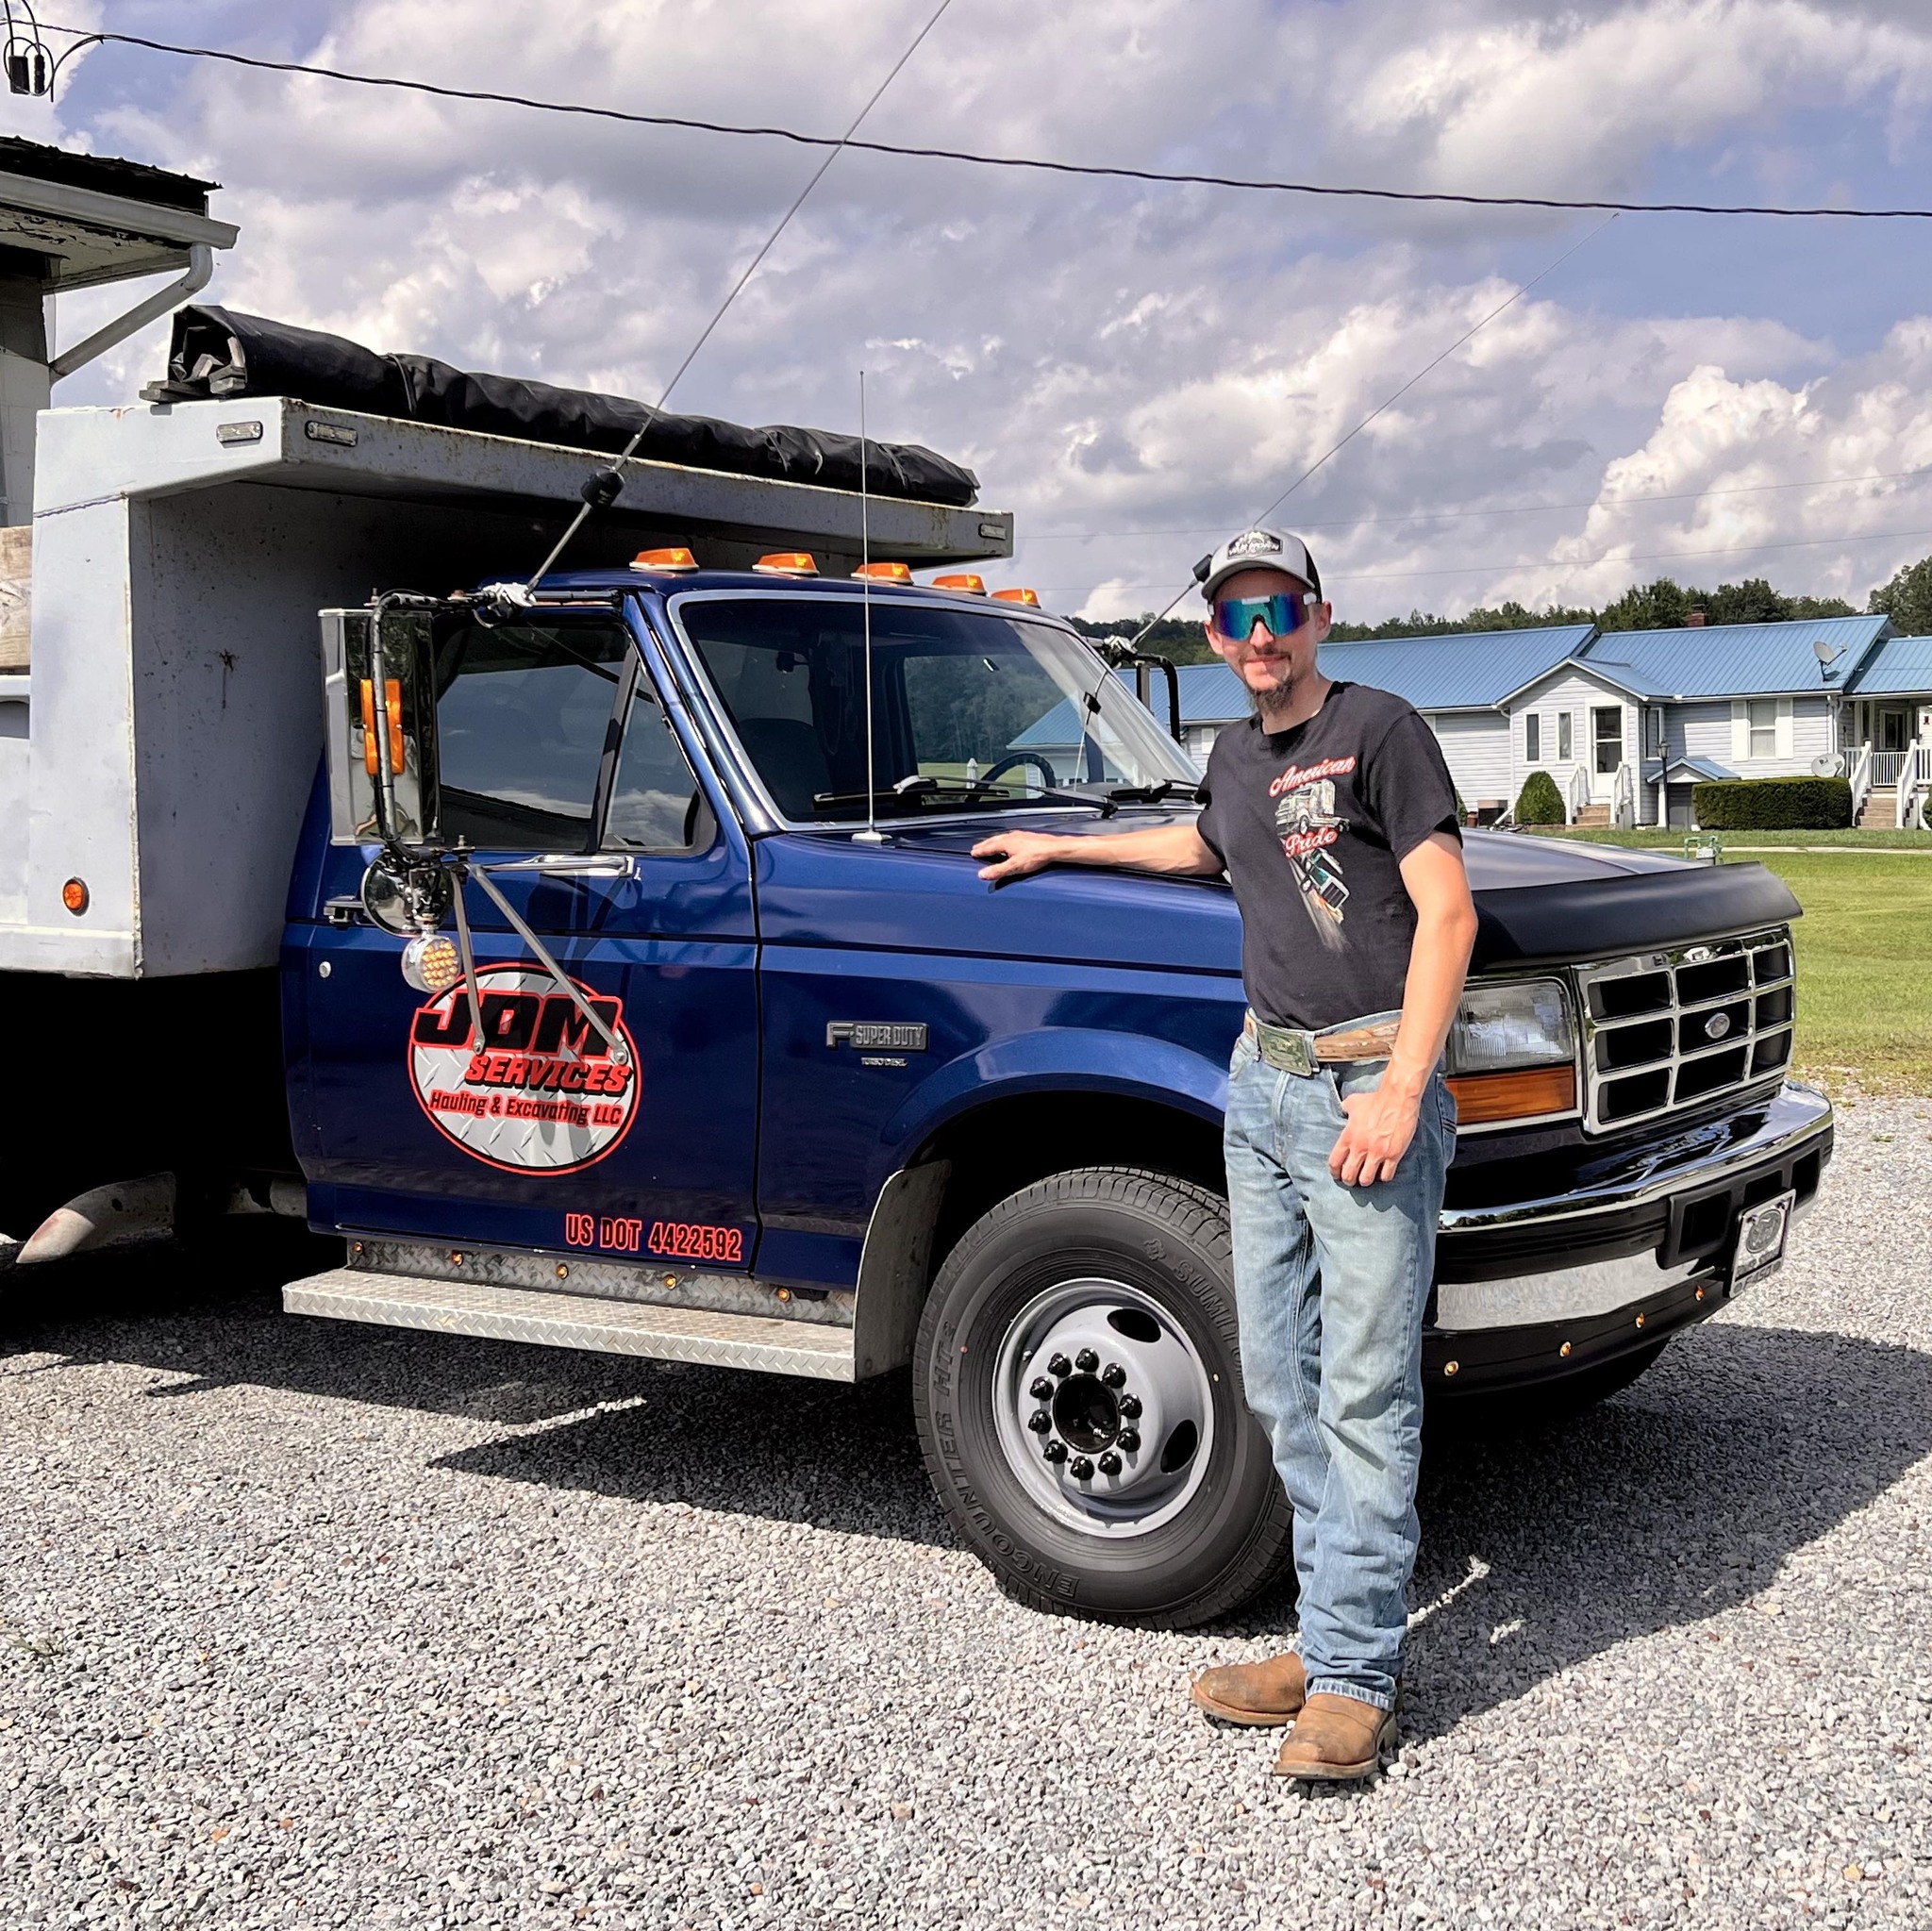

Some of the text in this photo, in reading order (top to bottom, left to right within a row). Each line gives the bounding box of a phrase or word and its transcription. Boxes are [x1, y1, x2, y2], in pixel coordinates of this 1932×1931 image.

[1269, 757, 1357, 797] American
[1285, 826, 1339, 857] Pride
[855, 1025, 891, 1045] SUPER
[893, 1026, 924, 1047] DUTY
[465, 1056, 631, 1094] SERVICES
[430, 1090, 623, 1125] Hauling & Excavating LLC
[566, 1213, 742, 1261] US DOT 4422592
[935, 1410, 1080, 1598] ENCOUNTER
